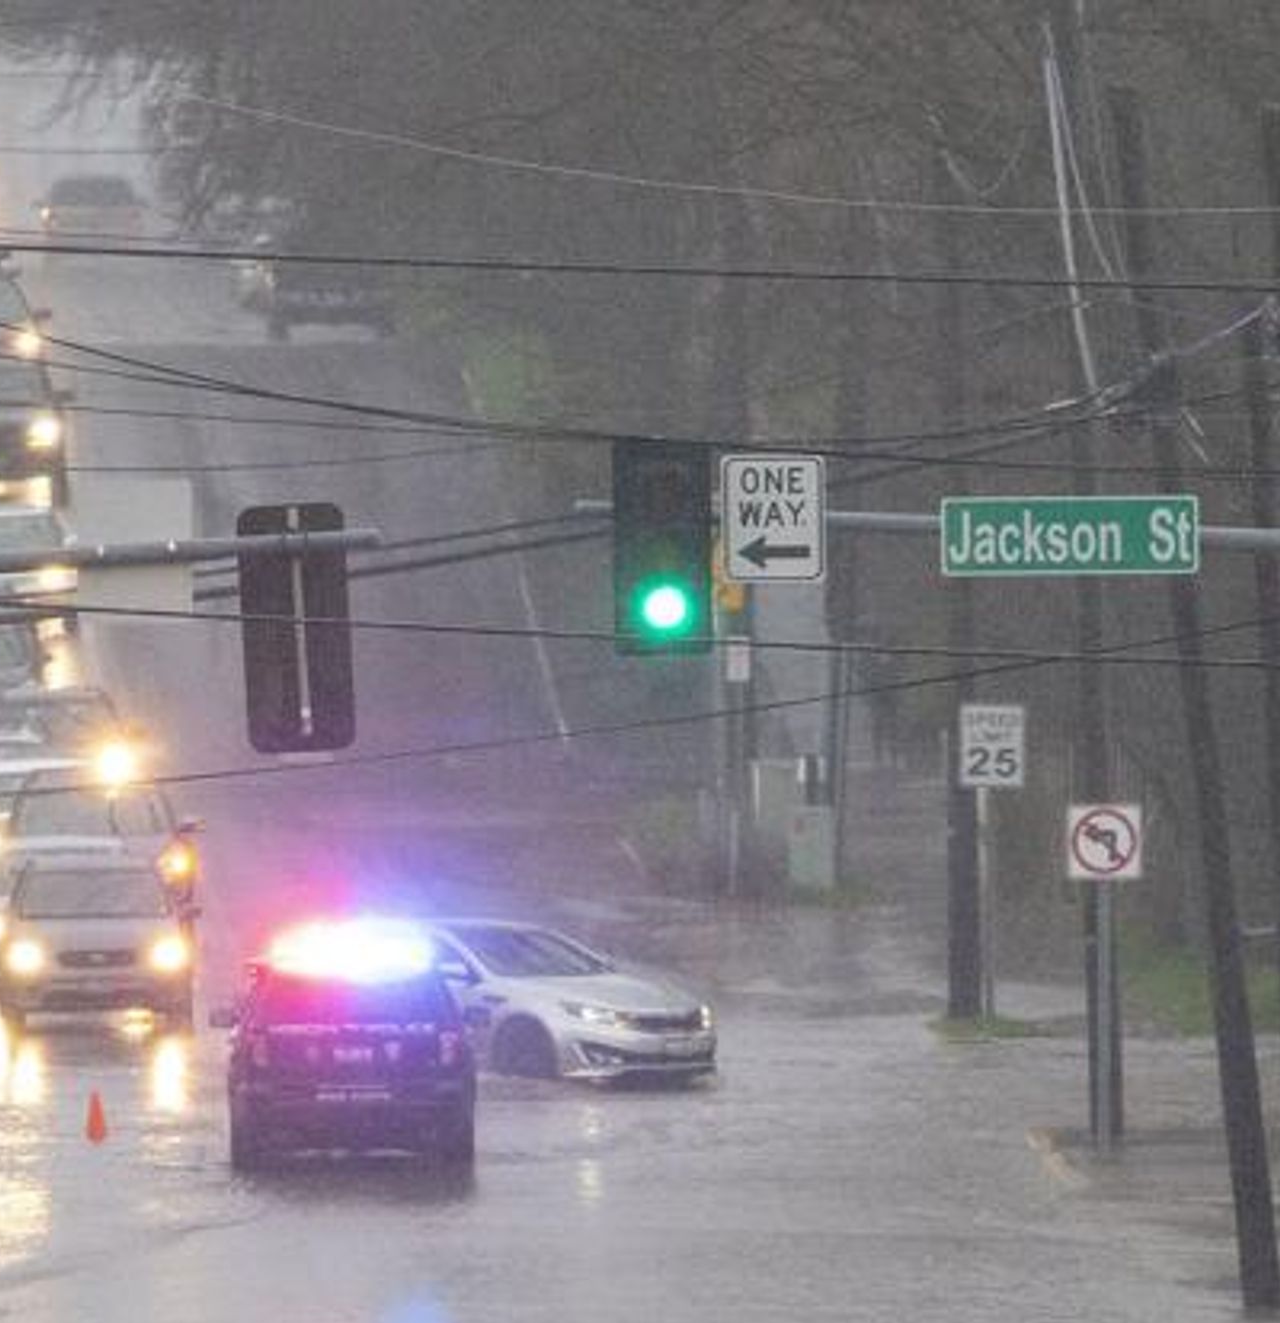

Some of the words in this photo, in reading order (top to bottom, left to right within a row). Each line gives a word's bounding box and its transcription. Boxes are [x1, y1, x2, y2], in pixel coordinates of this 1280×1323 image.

[740, 466, 805, 494] ONE
[738, 500, 806, 528] WAY
[948, 508, 1123, 564] Jackson
[1148, 507, 1193, 563] St
[967, 747, 1017, 778] 25
